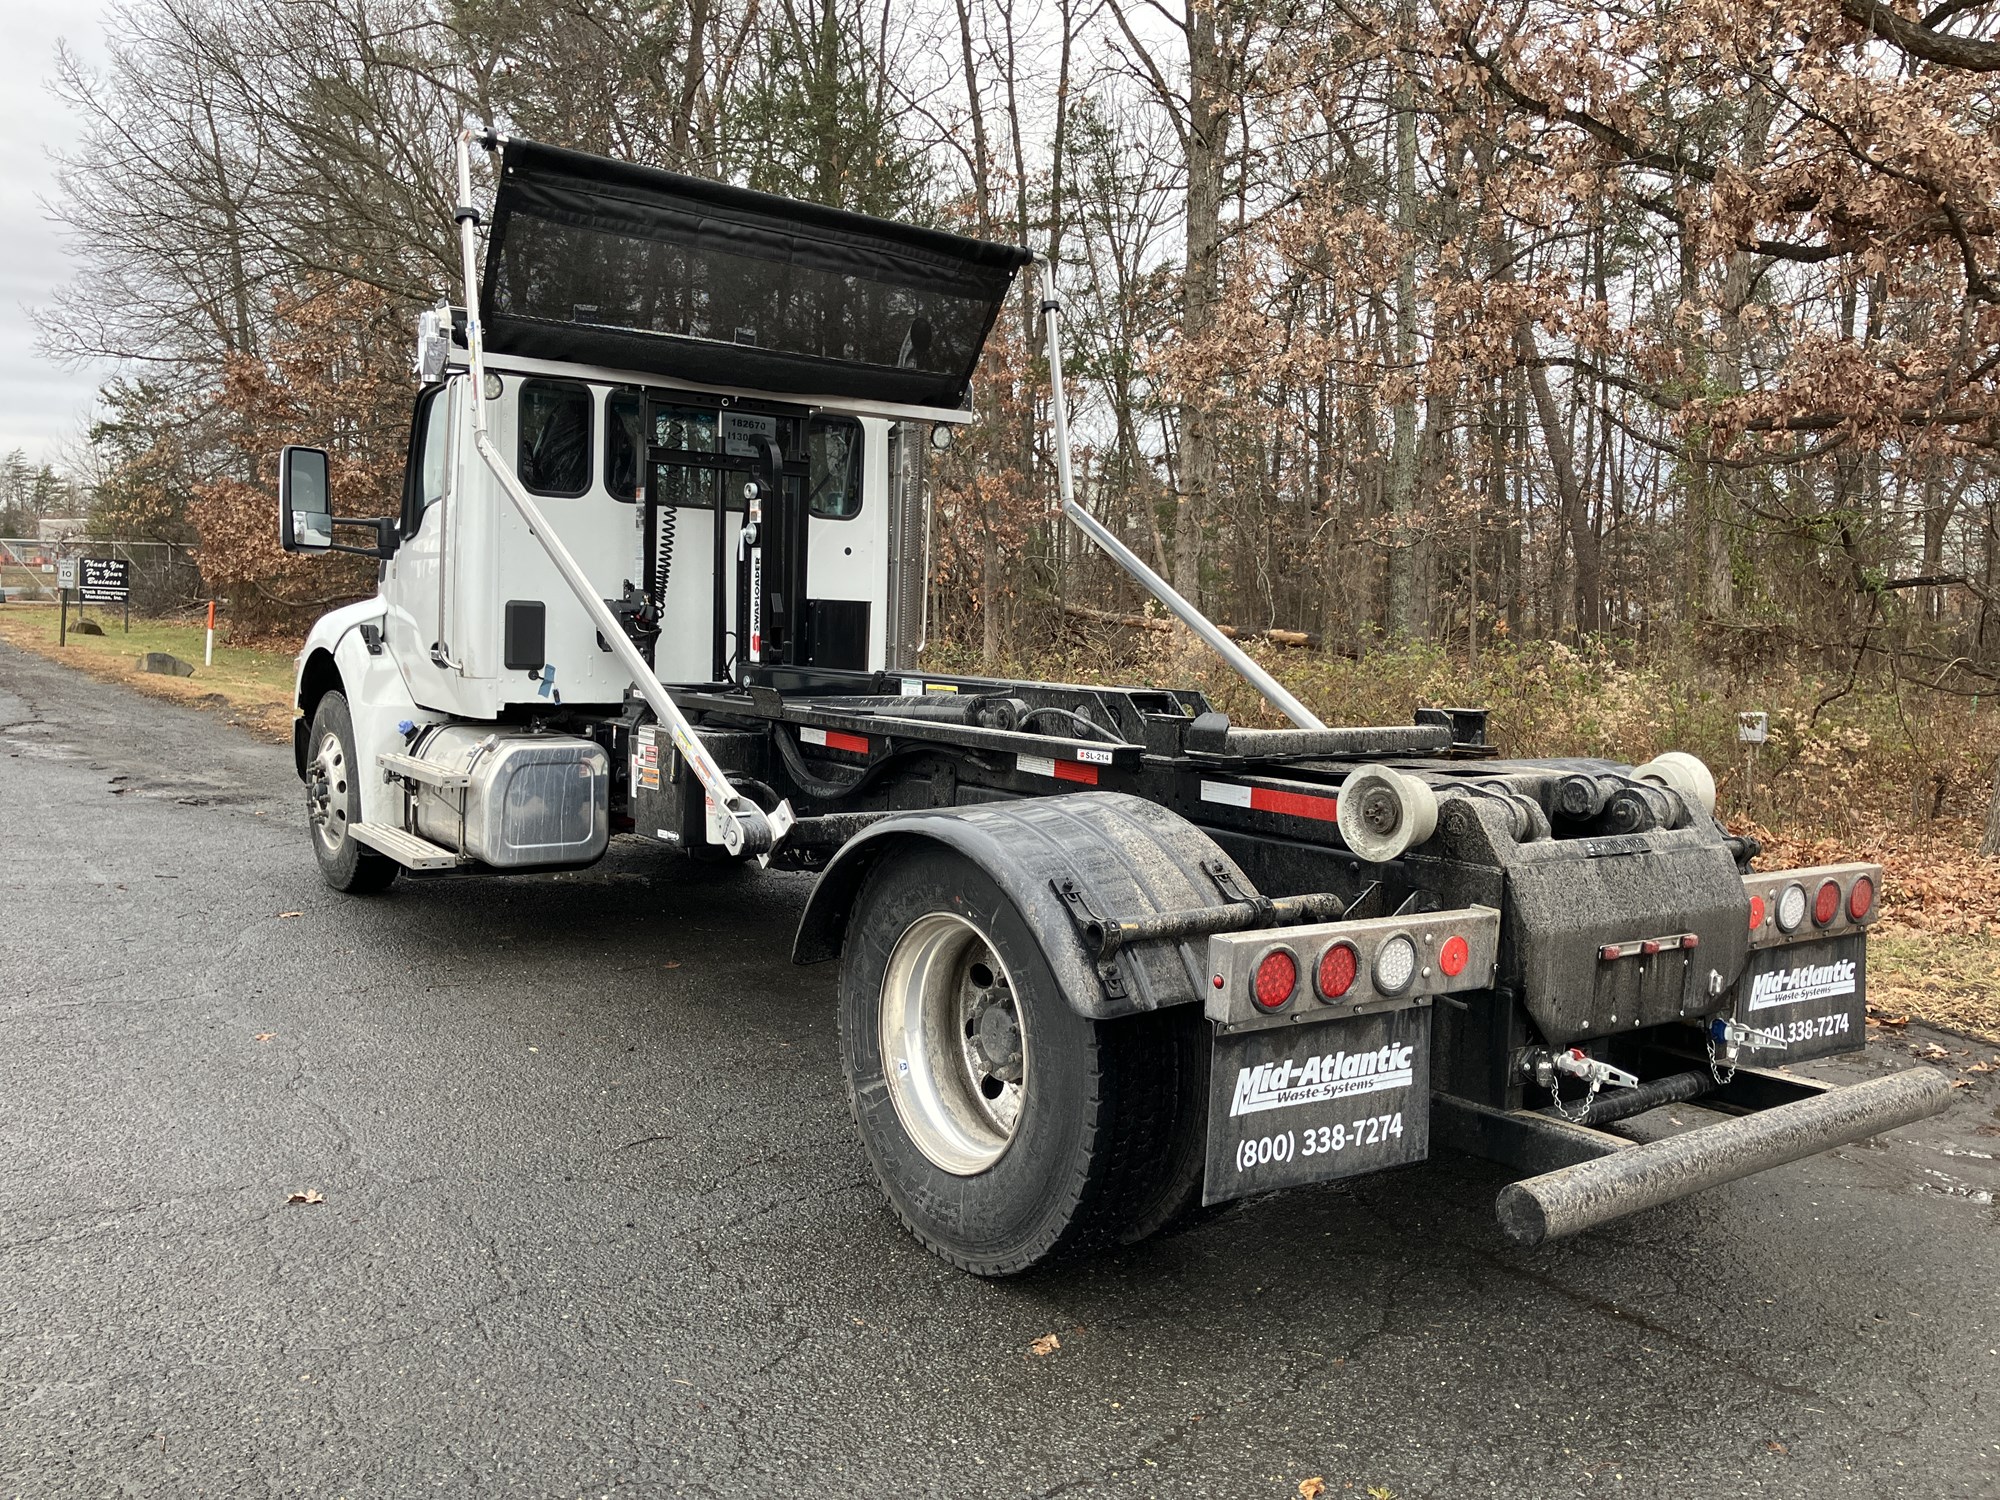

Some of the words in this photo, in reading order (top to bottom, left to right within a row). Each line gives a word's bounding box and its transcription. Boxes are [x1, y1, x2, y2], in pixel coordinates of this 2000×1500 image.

[732, 419, 766, 430] 182670
[62, 570, 72, 578] 10
[84, 560, 107, 568] Thank
[109, 561, 124, 571] You
[86, 568, 100, 577] For
[103, 569, 122, 579] Your
[87, 577, 121, 585] Business
[753, 557, 761, 632] SWAPLOADER
[1085, 751, 1109, 761] SL-214
[1748, 959, 1856, 1011] Mid-Atlantic
[1775, 993, 1799, 1003] Waste
[1800, 986, 1832, 999] Systems
[1787, 1013, 1849, 1043] 338-7274
[1230, 1042, 1413, 1117] Mid-Atlantic
[1277, 1087, 1319, 1103] Waste
[1322, 1078, 1374, 1098] Systems
[1236, 1131, 1295, 1172] (800)
[1301, 1113, 1403, 1156] 338-7274
